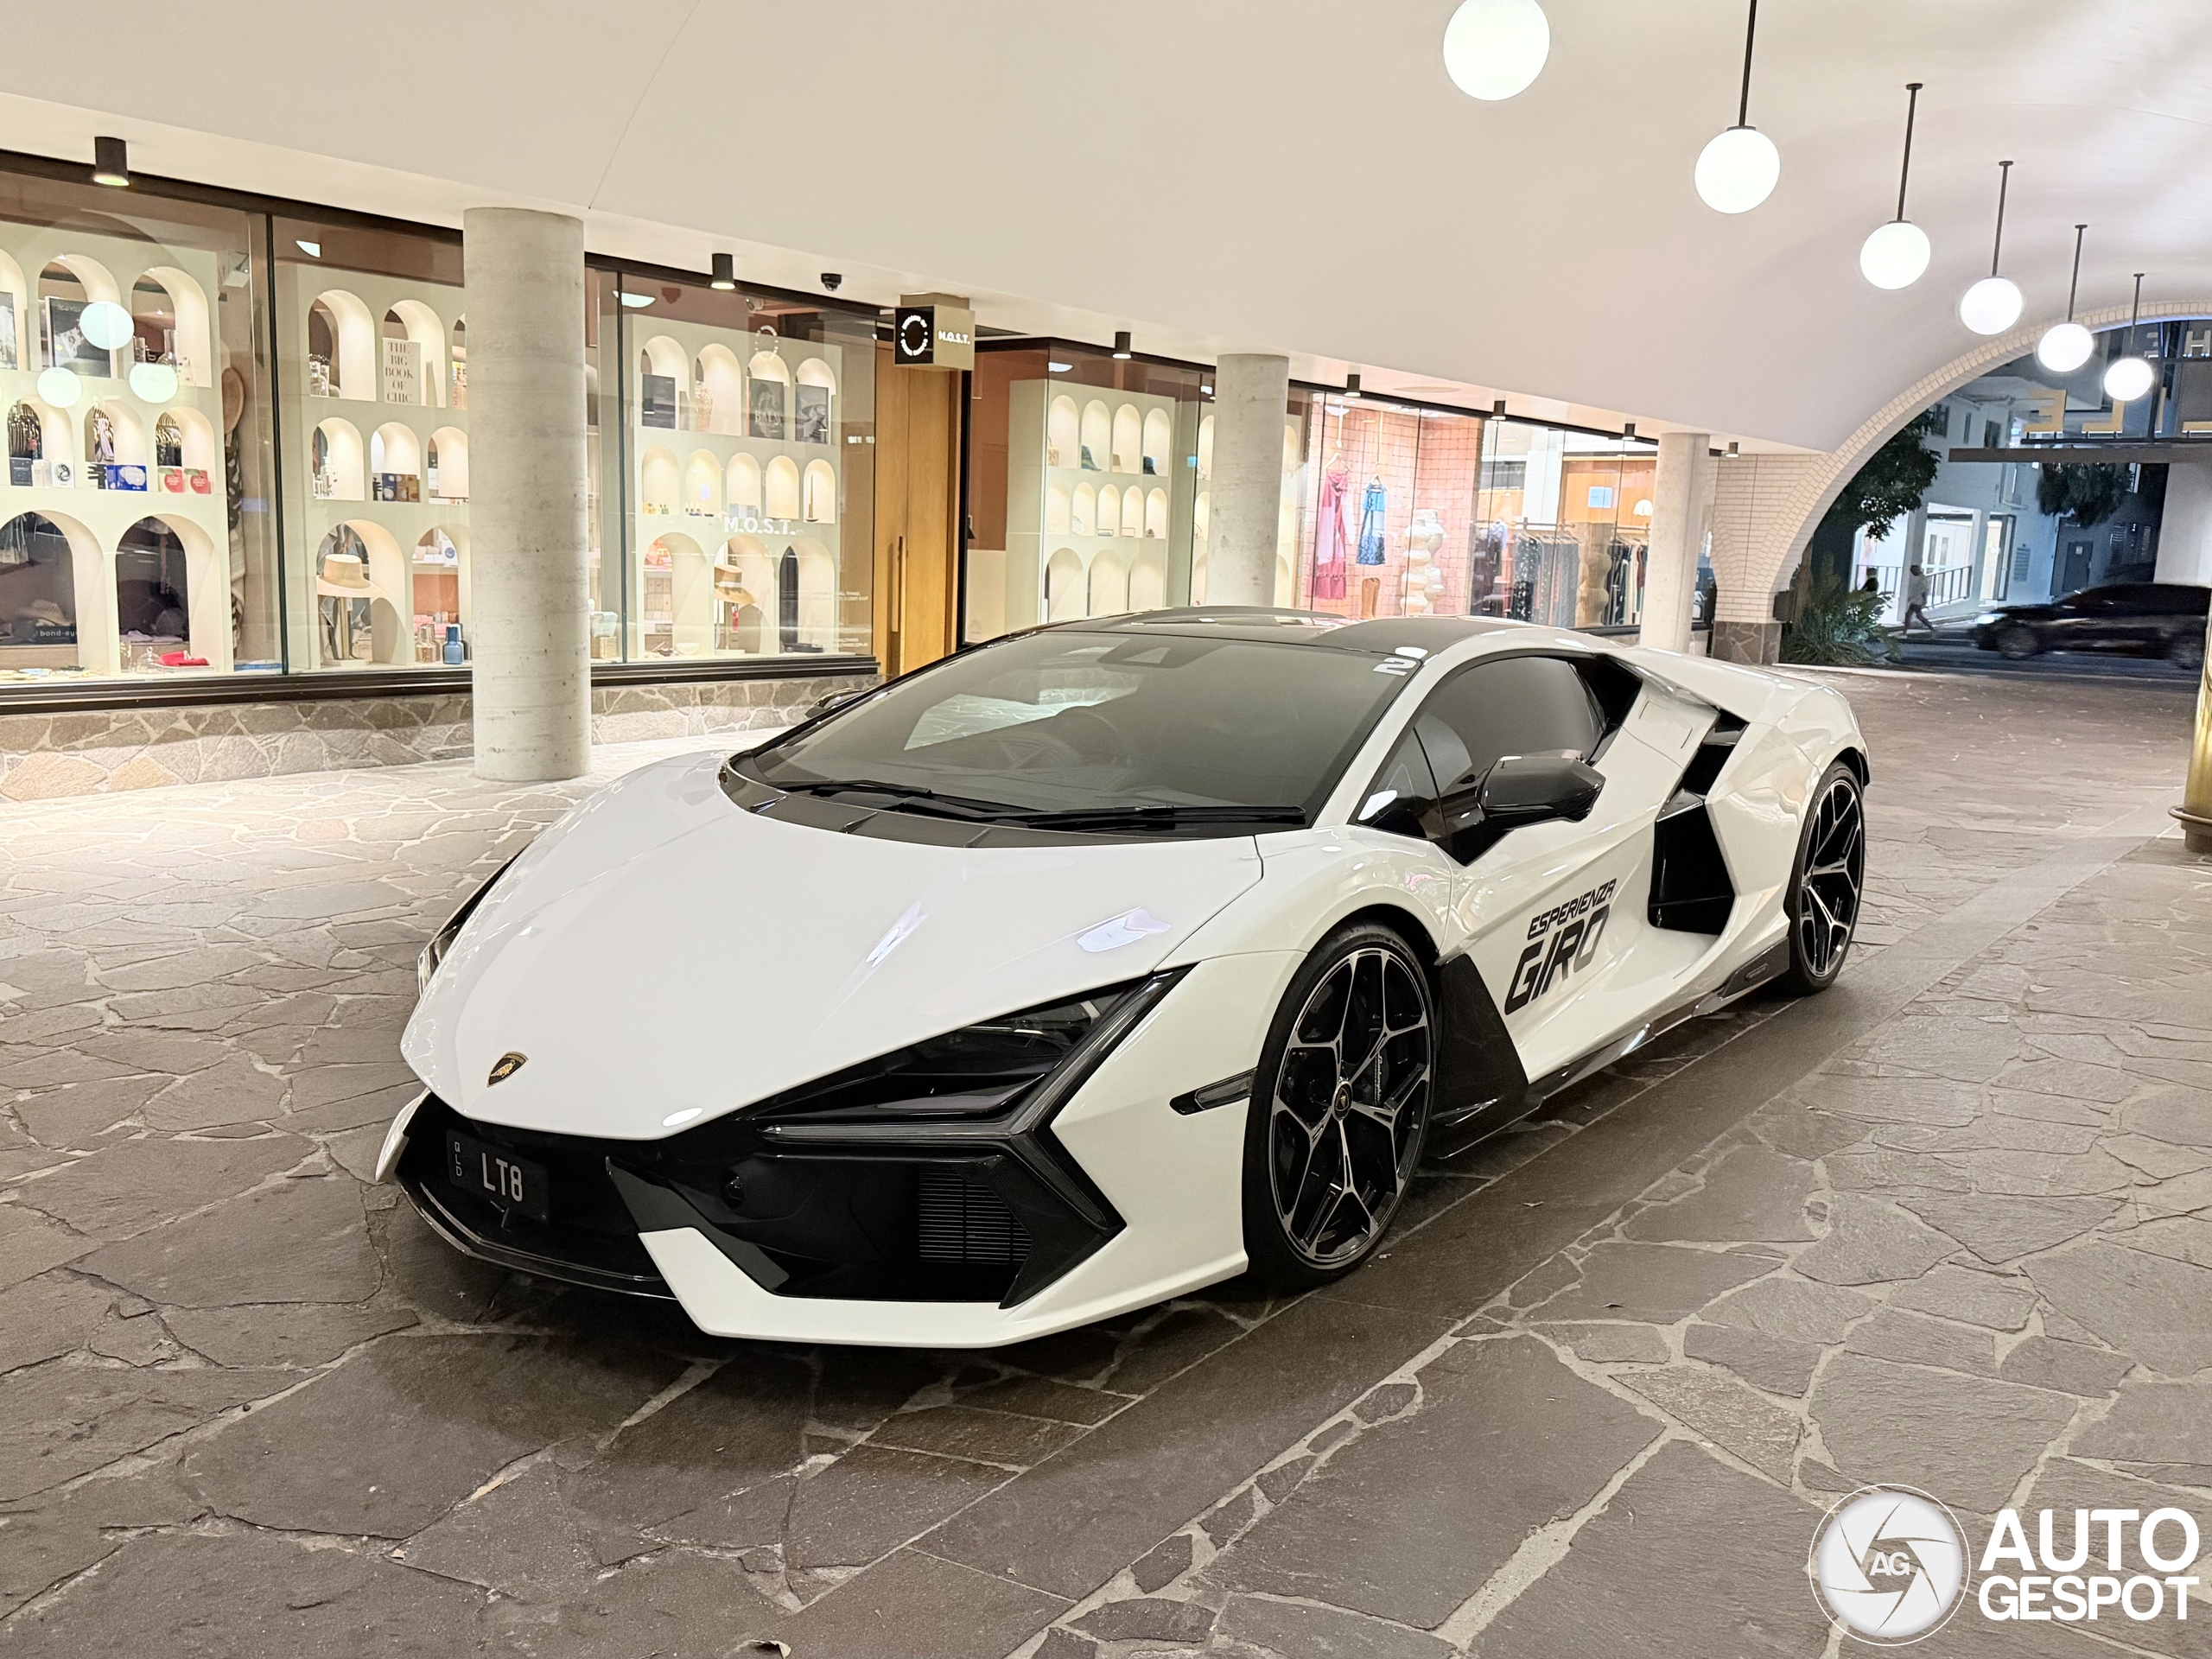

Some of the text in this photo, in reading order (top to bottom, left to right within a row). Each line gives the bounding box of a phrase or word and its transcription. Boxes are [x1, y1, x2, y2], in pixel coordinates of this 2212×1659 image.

[938, 330, 970, 345] M.O.S.T.
[388, 342, 410, 353] THE
[391, 354, 408, 365] BIG
[385, 367, 414, 378] BOOK
[392, 380, 406, 391] OF
[386, 392, 413, 404] CHIC
[724, 517, 796, 536] M.O.S.T.
[1527, 878, 1618, 940] ESPERIENZA
[1504, 904, 1611, 1015] GIRO
[481, 1152, 523, 1202] LT8
